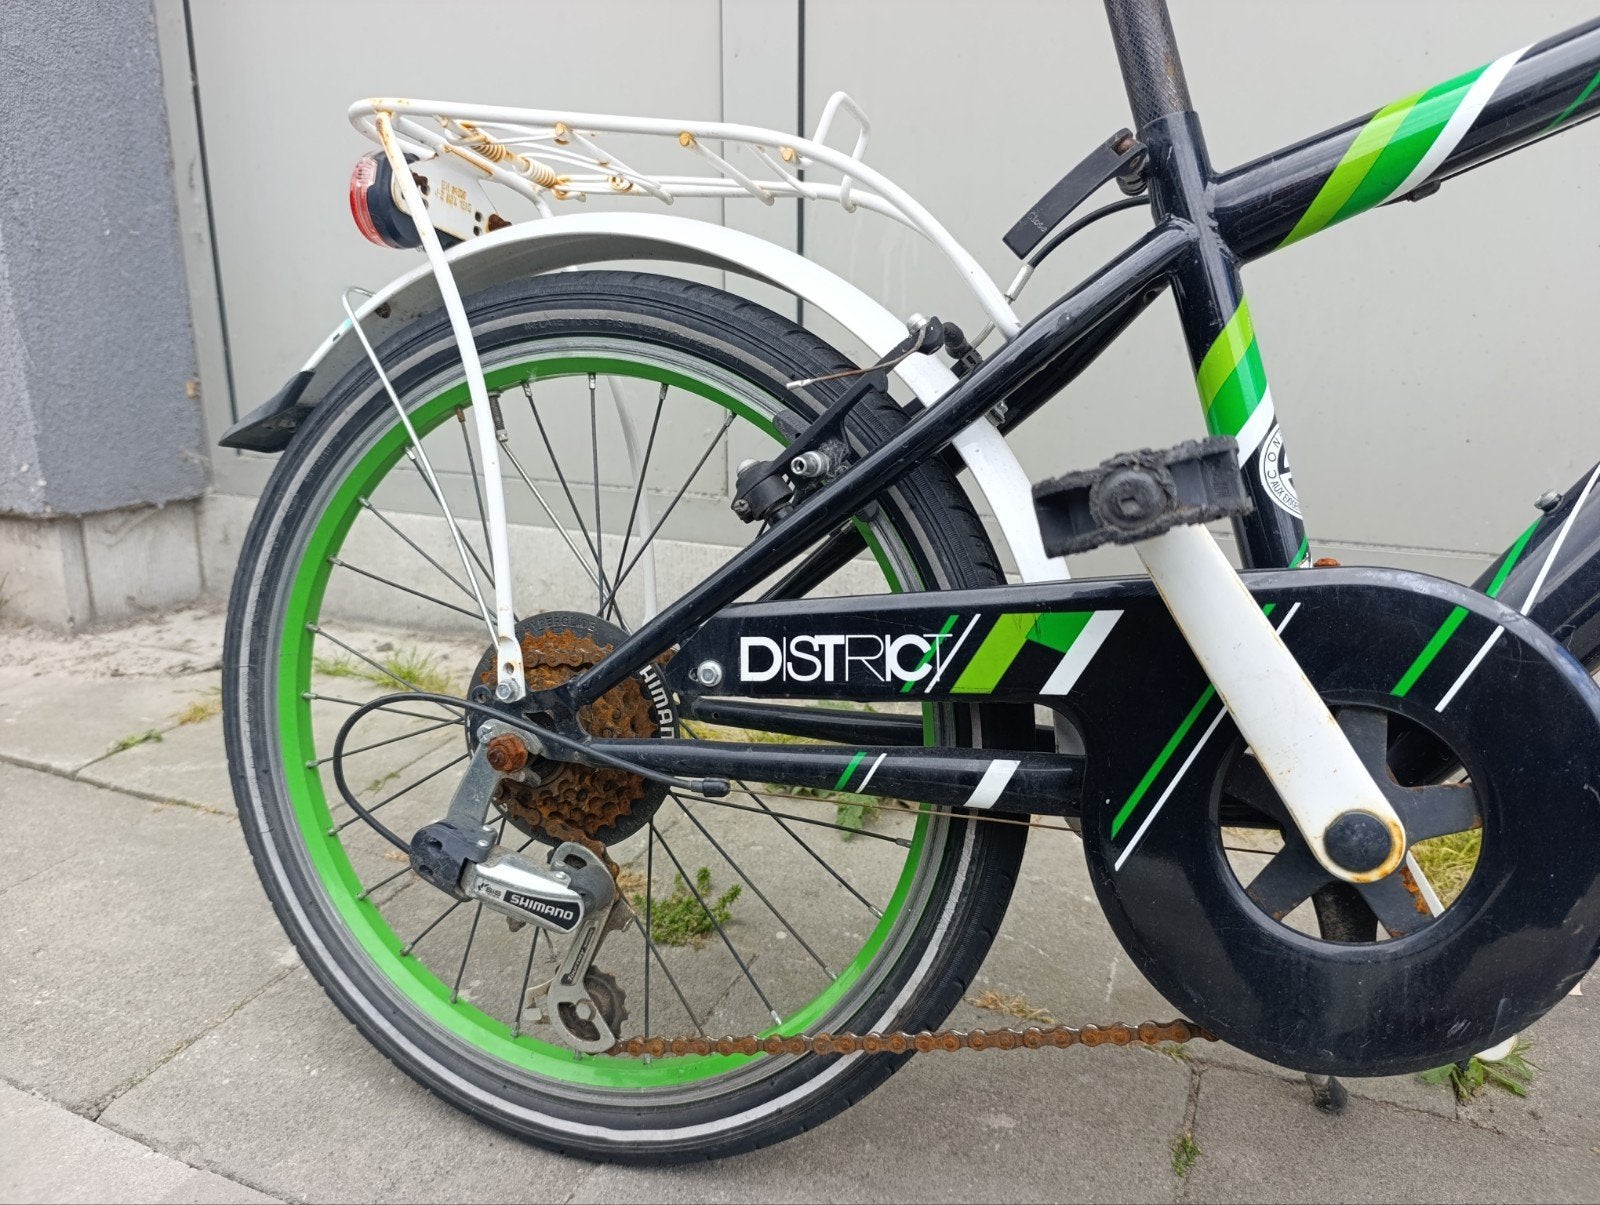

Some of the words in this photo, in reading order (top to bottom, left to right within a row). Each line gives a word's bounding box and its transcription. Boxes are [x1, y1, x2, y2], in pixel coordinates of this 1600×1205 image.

[1270, 481, 1285, 496] AUX
[523, 616, 597, 632] HYPERGLIDE
[740, 633, 953, 683] DISTRICT
[640, 664, 675, 739] HIMAN
[510, 894, 574, 921] SHIMANO
